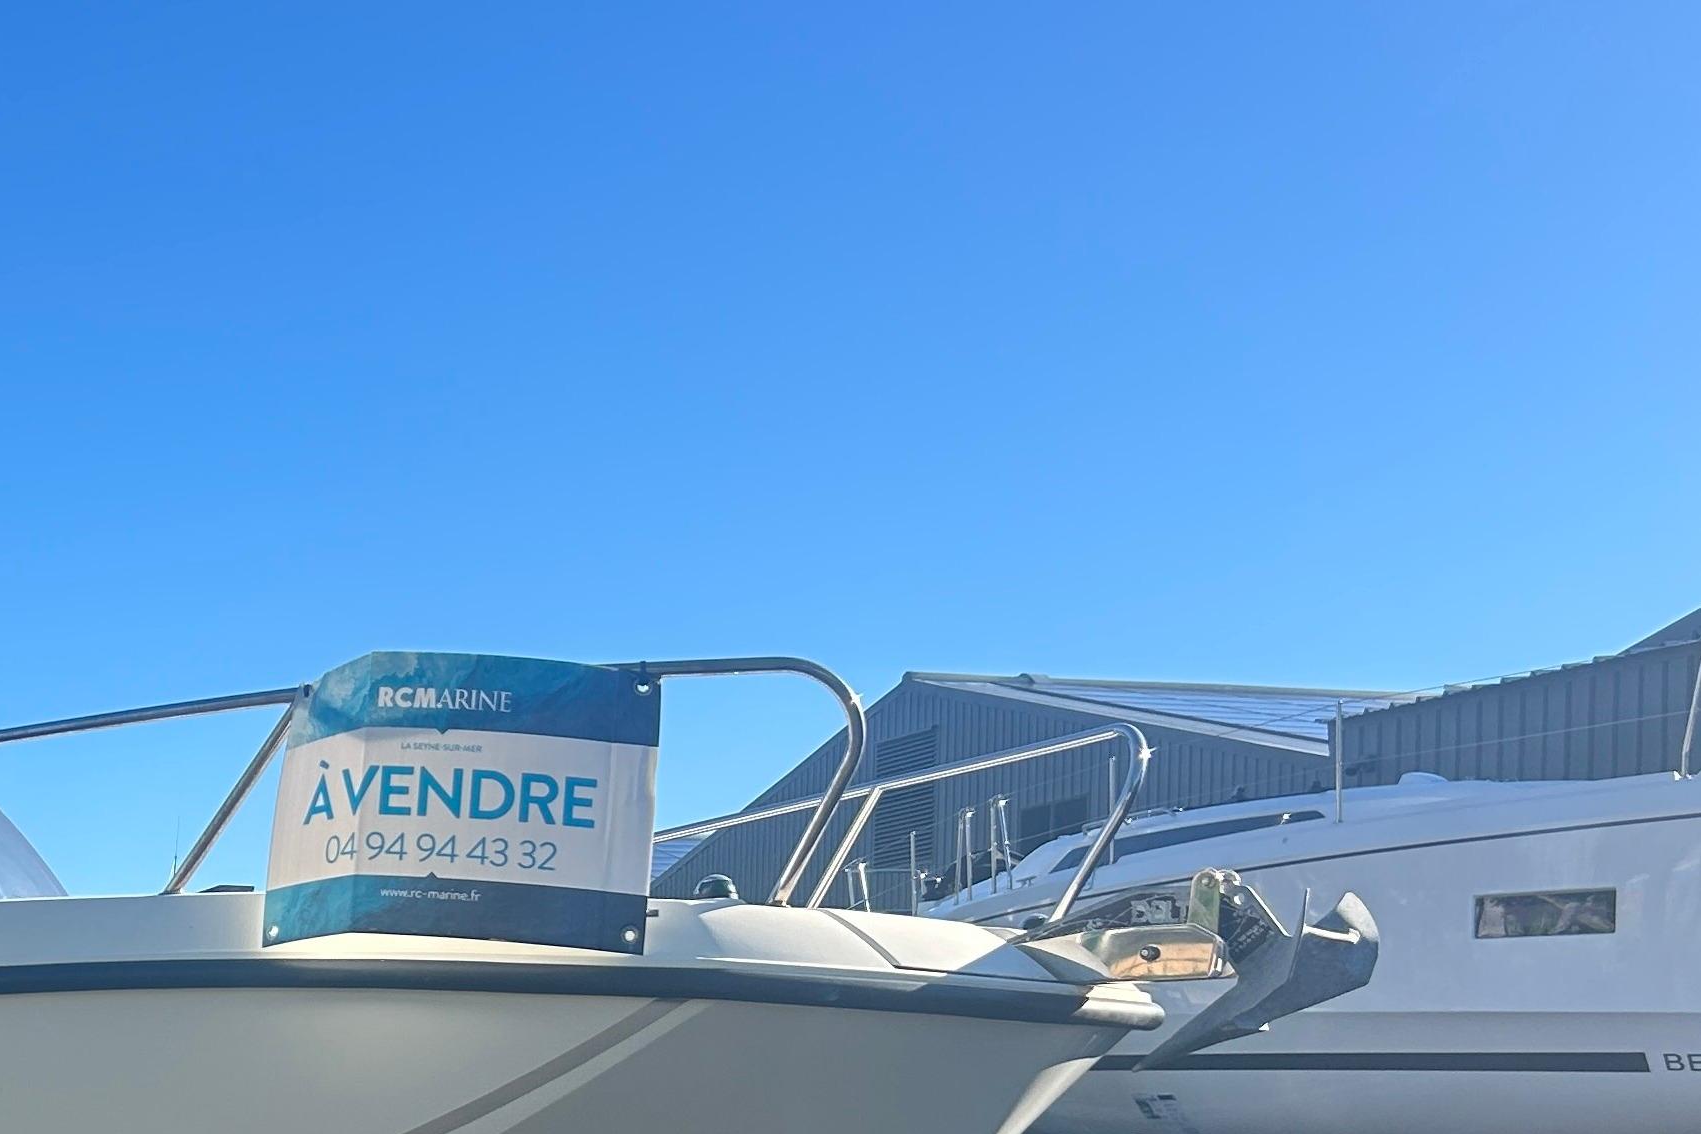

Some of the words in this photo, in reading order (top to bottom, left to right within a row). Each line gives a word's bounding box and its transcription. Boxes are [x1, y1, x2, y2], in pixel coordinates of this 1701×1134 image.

[302, 759, 335, 826] À
[341, 764, 599, 829] VENDRE
[325, 831, 358, 864] 04
[365, 831, 408, 861] 94
[416, 833, 459, 863] 94
[465, 836, 509, 867] 43
[517, 840, 558, 871] 32
[379, 887, 482, 902] www.rc-marine.fr
